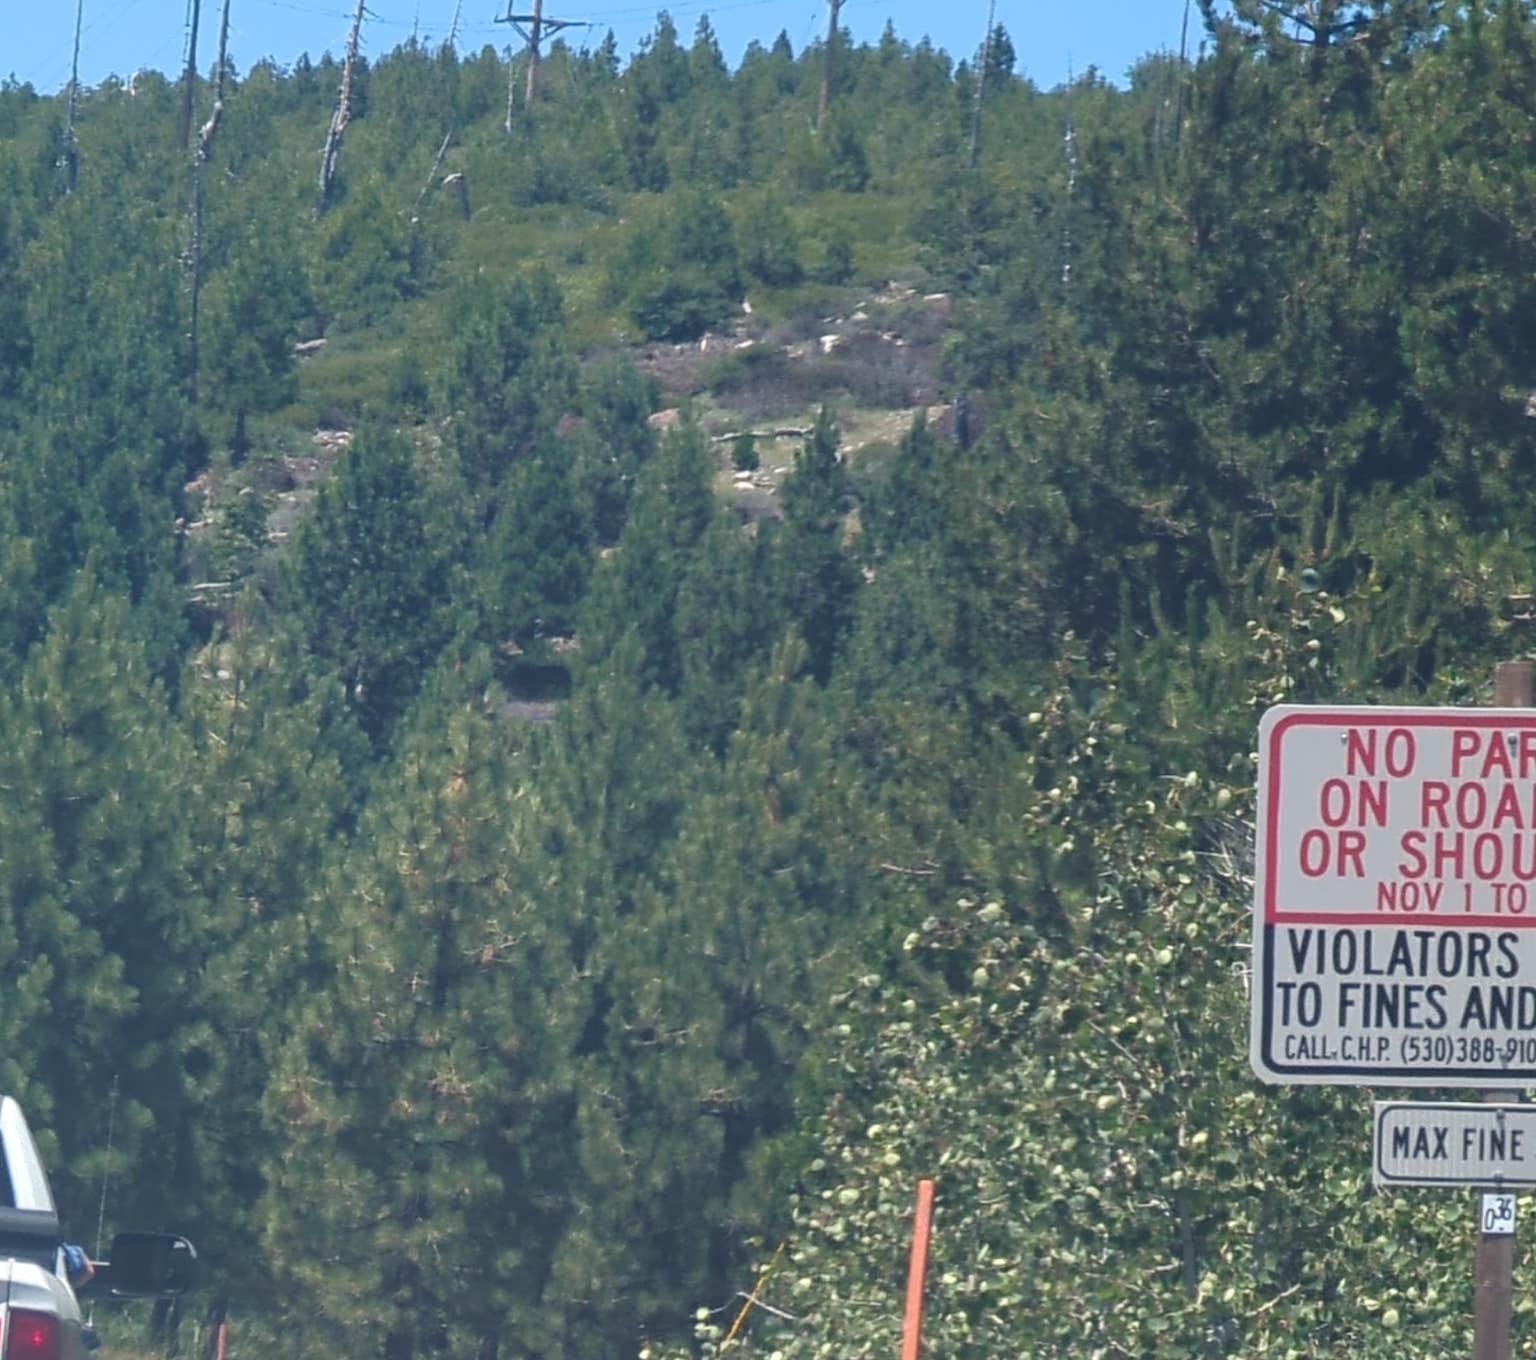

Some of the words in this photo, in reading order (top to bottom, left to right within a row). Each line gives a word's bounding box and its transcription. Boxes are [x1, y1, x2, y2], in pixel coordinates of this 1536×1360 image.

[1347, 728, 1415, 778] NO
[1320, 778, 1388, 828] ON
[1421, 781, 1536, 830] ROA
[1299, 829, 1367, 878] OR
[1377, 881, 1443, 912] NOV
[1465, 884, 1472, 913] 1
[1491, 883, 1527, 914] TO
[1288, 928, 1519, 979] VIOLATORS
[1277, 982, 1322, 1027] TO
[1338, 983, 1447, 1030] FINES
[1460, 985, 1536, 1031] AND
[1285, 1034, 1331, 1060] CALL
[1341, 1035, 1390, 1062] C.H.P.
[1392, 1126, 1448, 1159] MAX
[1463, 1127, 1524, 1161] FINE
